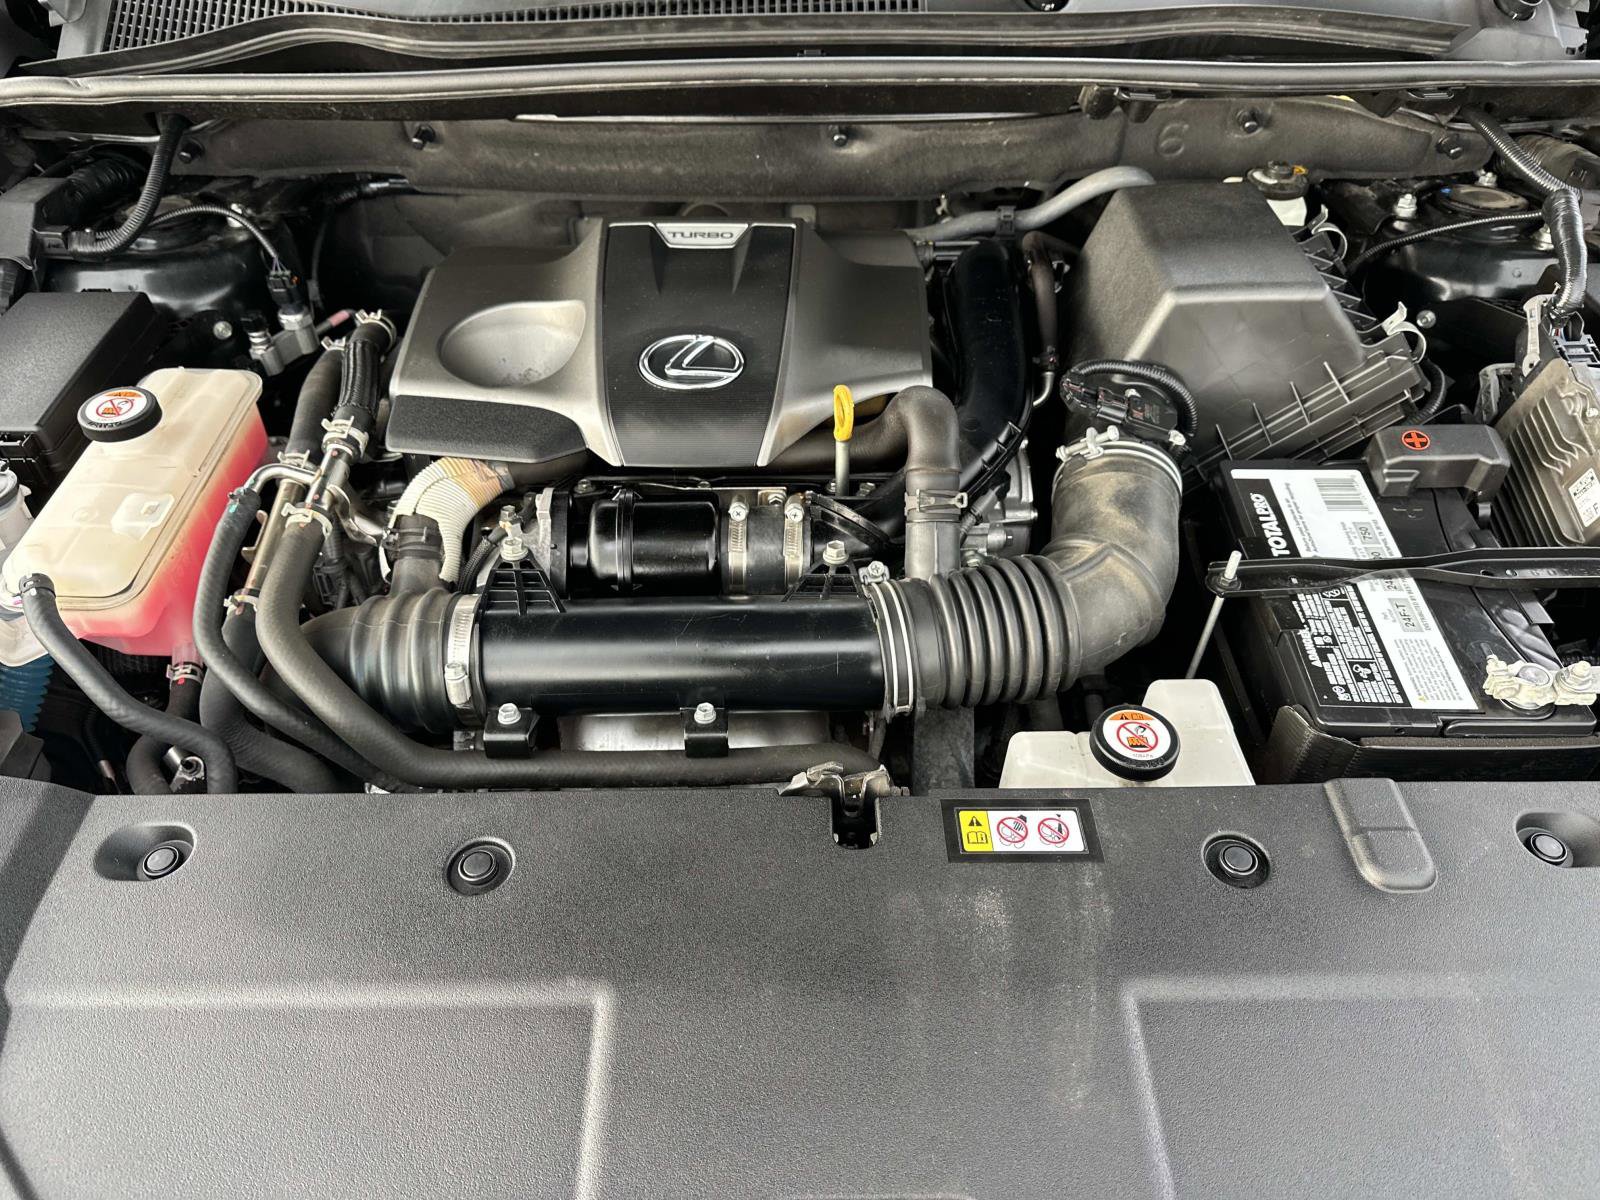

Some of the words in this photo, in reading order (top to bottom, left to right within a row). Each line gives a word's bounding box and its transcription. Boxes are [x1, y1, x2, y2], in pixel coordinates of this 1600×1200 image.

[667, 231, 734, 239] TURBO
[1249, 493, 1291, 556] TOTALPRO
[1357, 526, 1373, 540] 750
[1394, 602, 1416, 627] 24F-T
